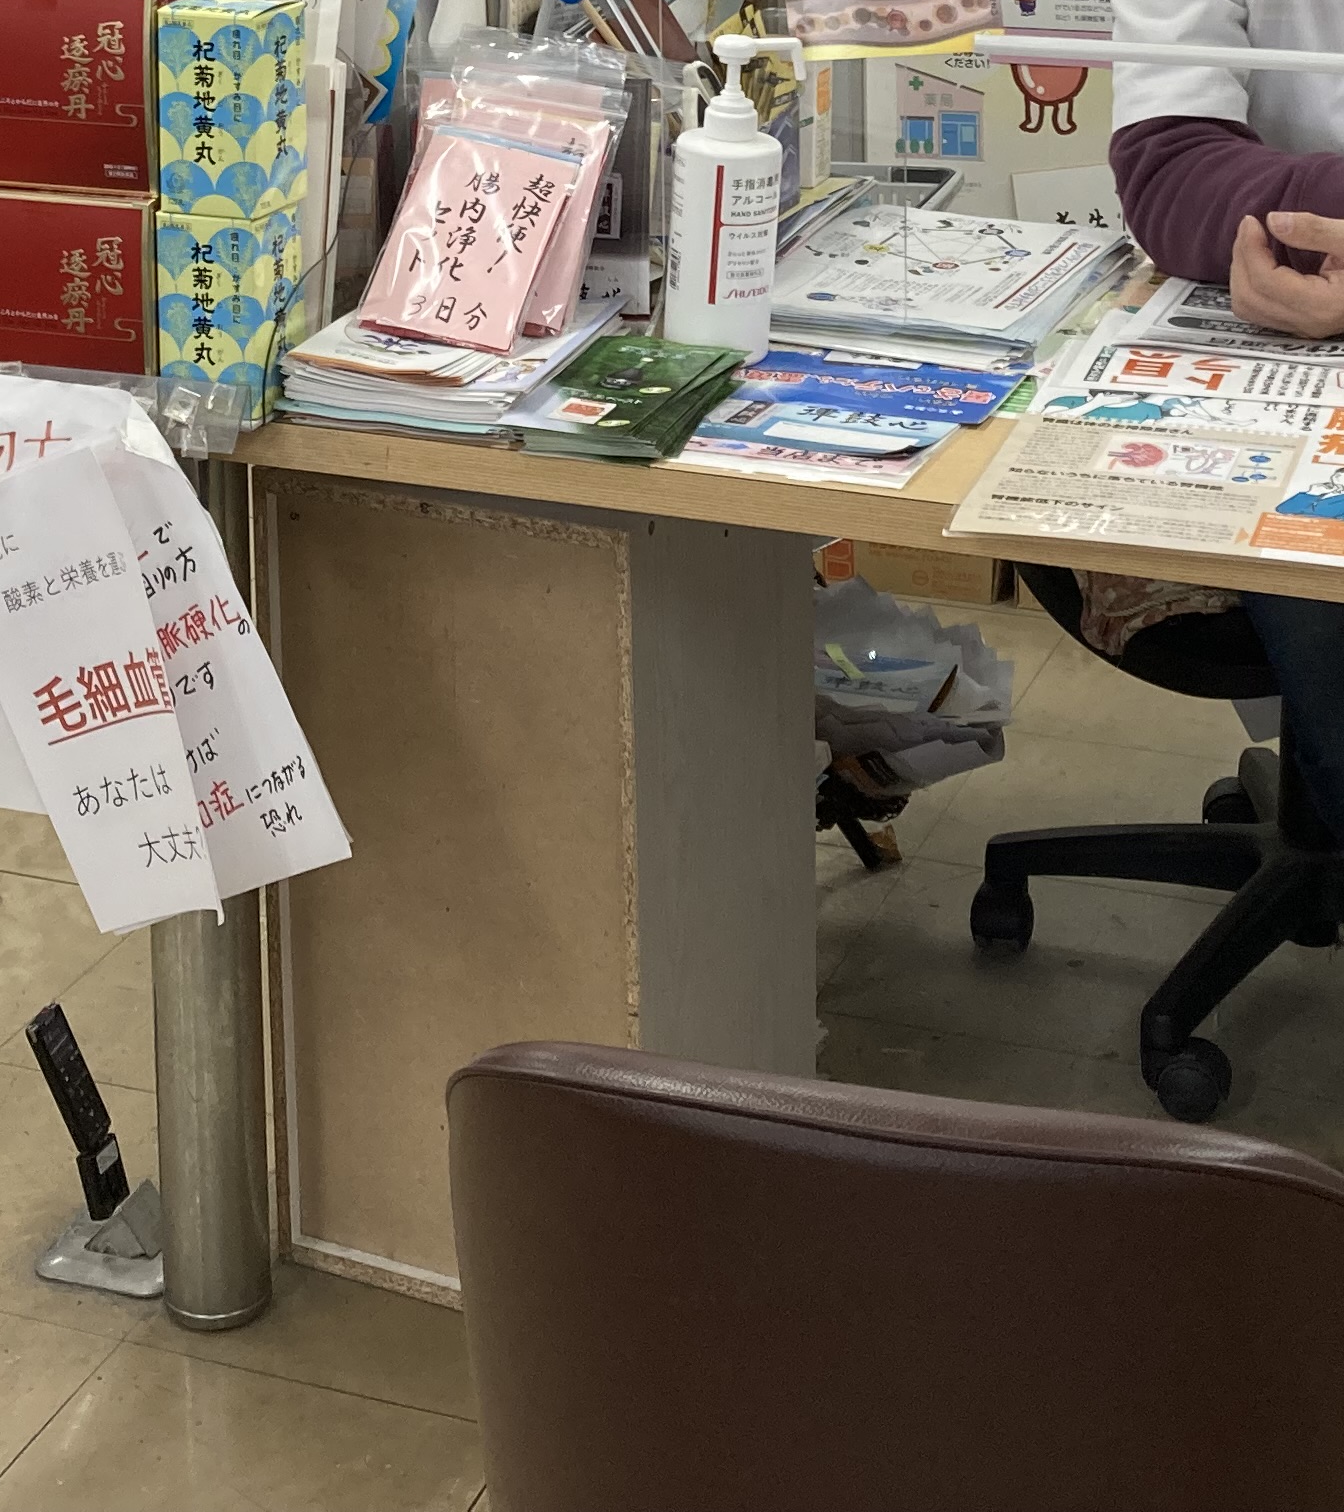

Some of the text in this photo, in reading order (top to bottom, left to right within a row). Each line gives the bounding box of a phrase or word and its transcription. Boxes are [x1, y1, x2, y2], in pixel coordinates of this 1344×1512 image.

[193, 39, 217, 166] 杞菊地黄丸
[191, 243, 217, 367] 杞菊地黄丸
[73, 763, 173, 817] あなたは
